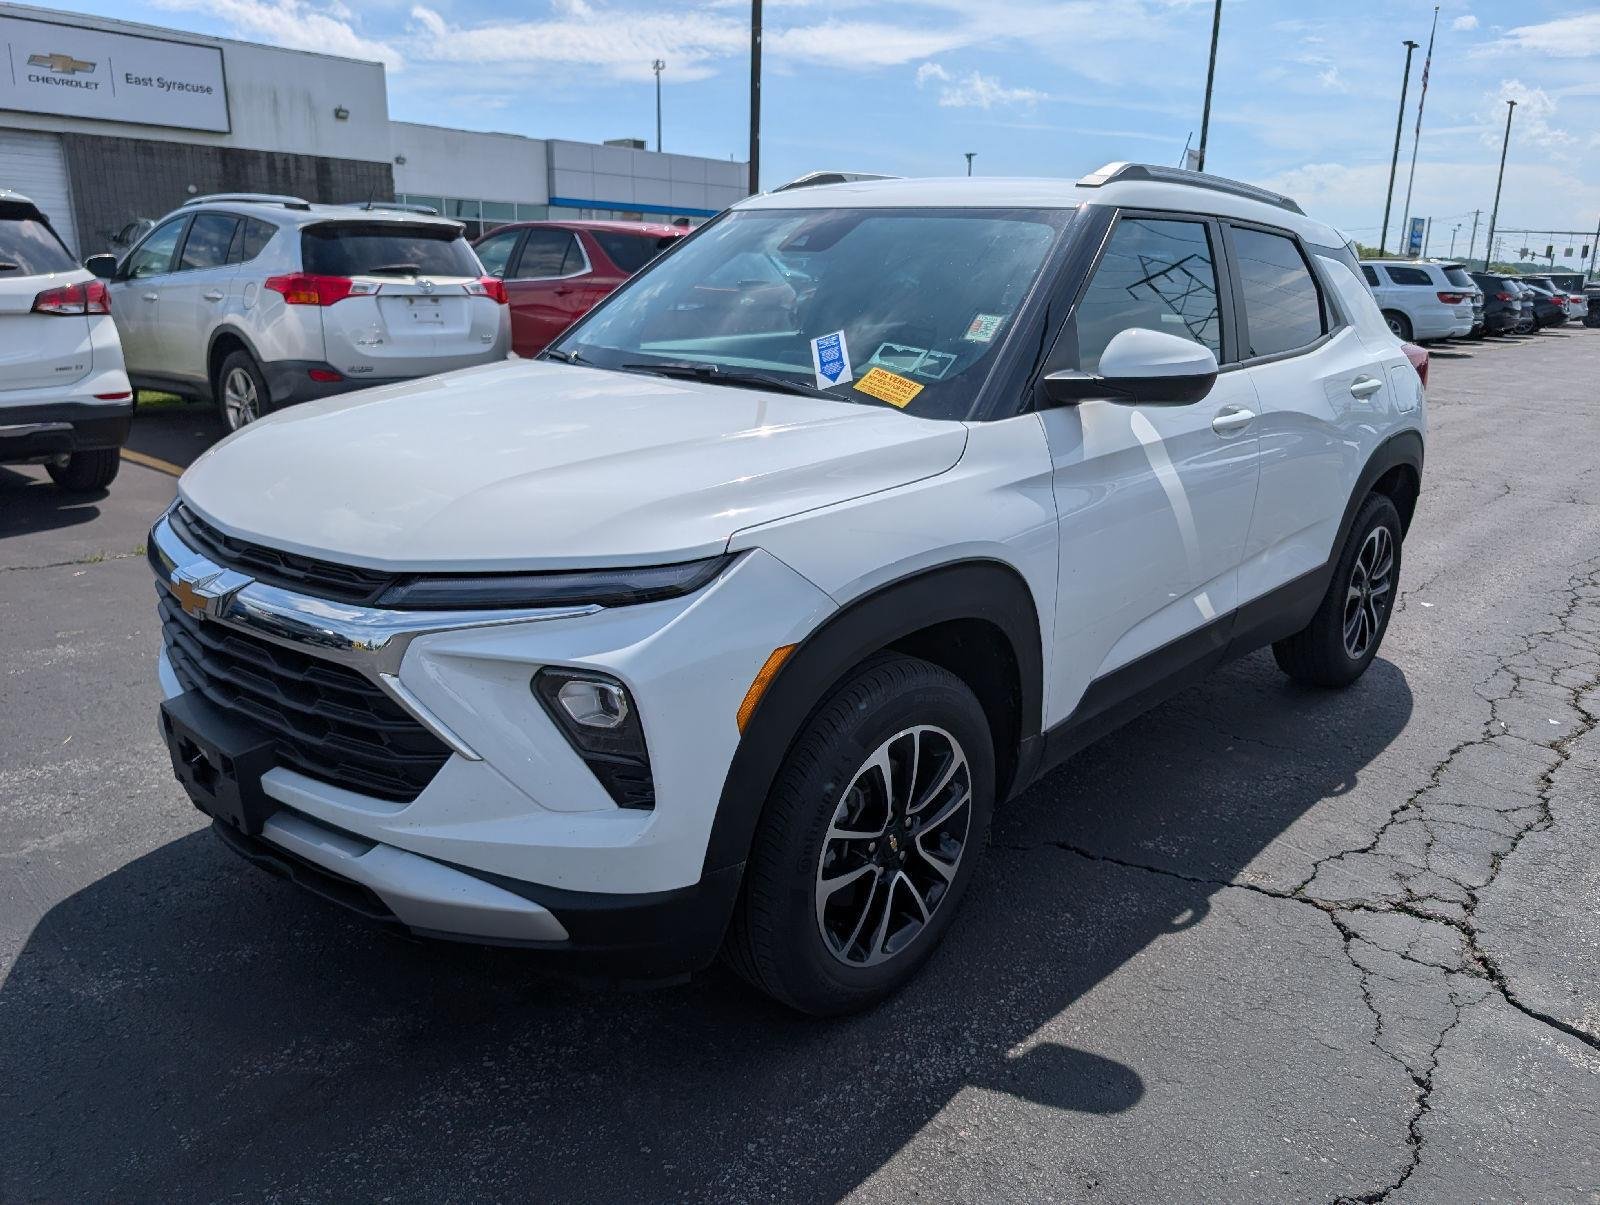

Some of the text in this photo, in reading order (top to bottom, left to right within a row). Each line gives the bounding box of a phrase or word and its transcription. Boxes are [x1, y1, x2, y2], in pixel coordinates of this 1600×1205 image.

[27, 74, 100, 90] CHEVROLET
[124, 73, 214, 95] East Syracuse
[871, 369, 889, 378] THIS
